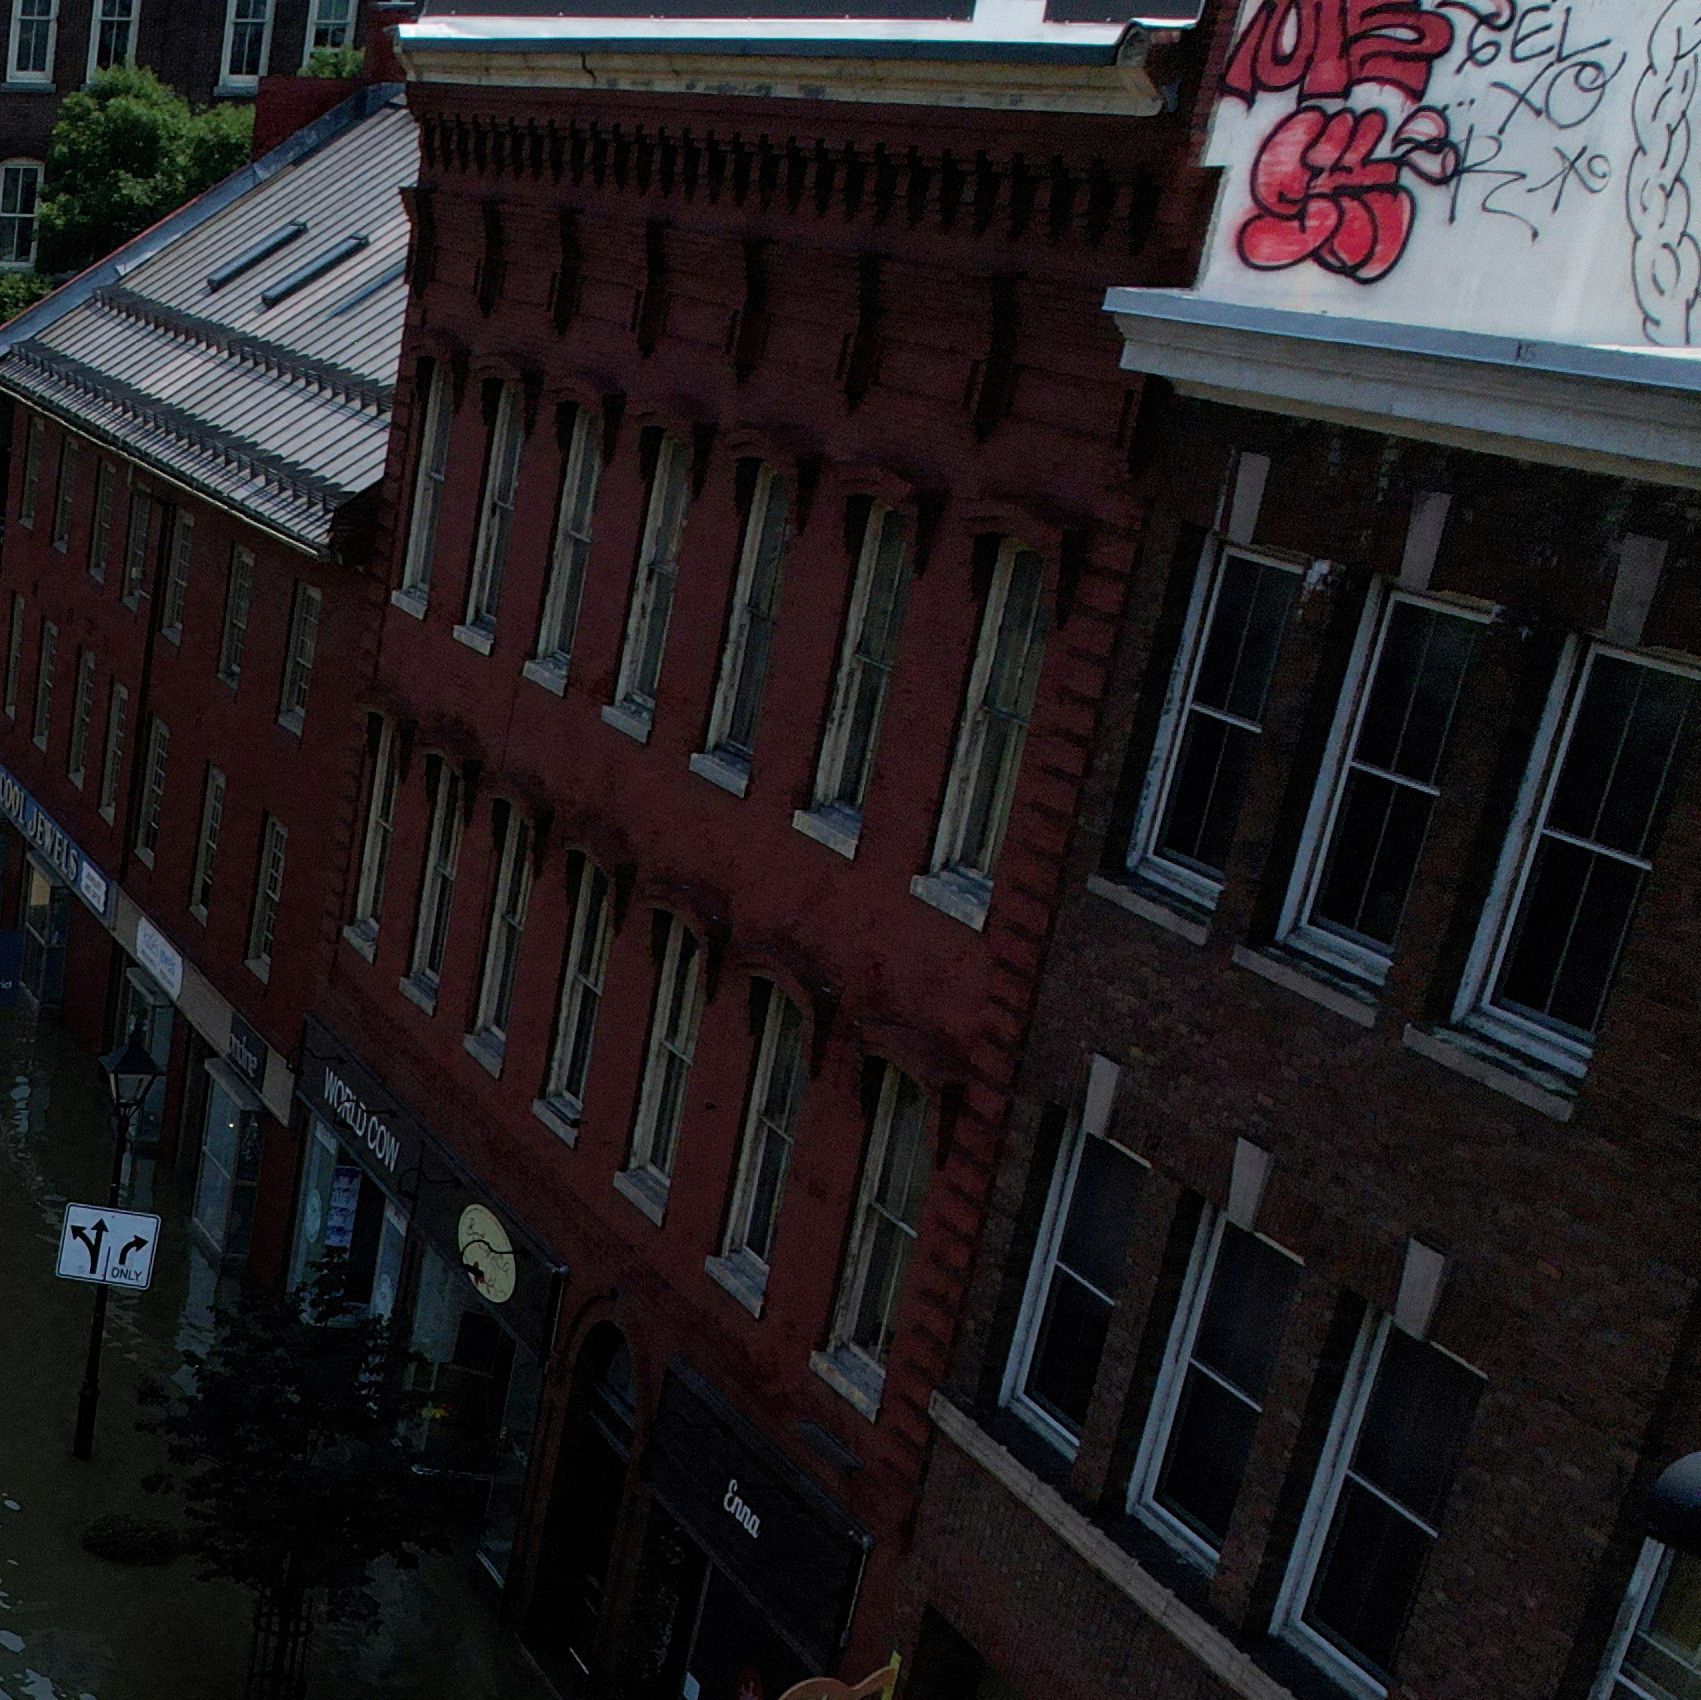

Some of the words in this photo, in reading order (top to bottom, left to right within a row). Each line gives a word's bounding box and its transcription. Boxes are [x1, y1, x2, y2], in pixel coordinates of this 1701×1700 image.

[27, 805, 80, 883] JEWELS
[324, 1065, 368, 1138] WORLD
[368, 1115, 401, 1173] COW
[111, 1266, 143, 1281] ONLY
[721, 1477, 761, 1540] Enna
